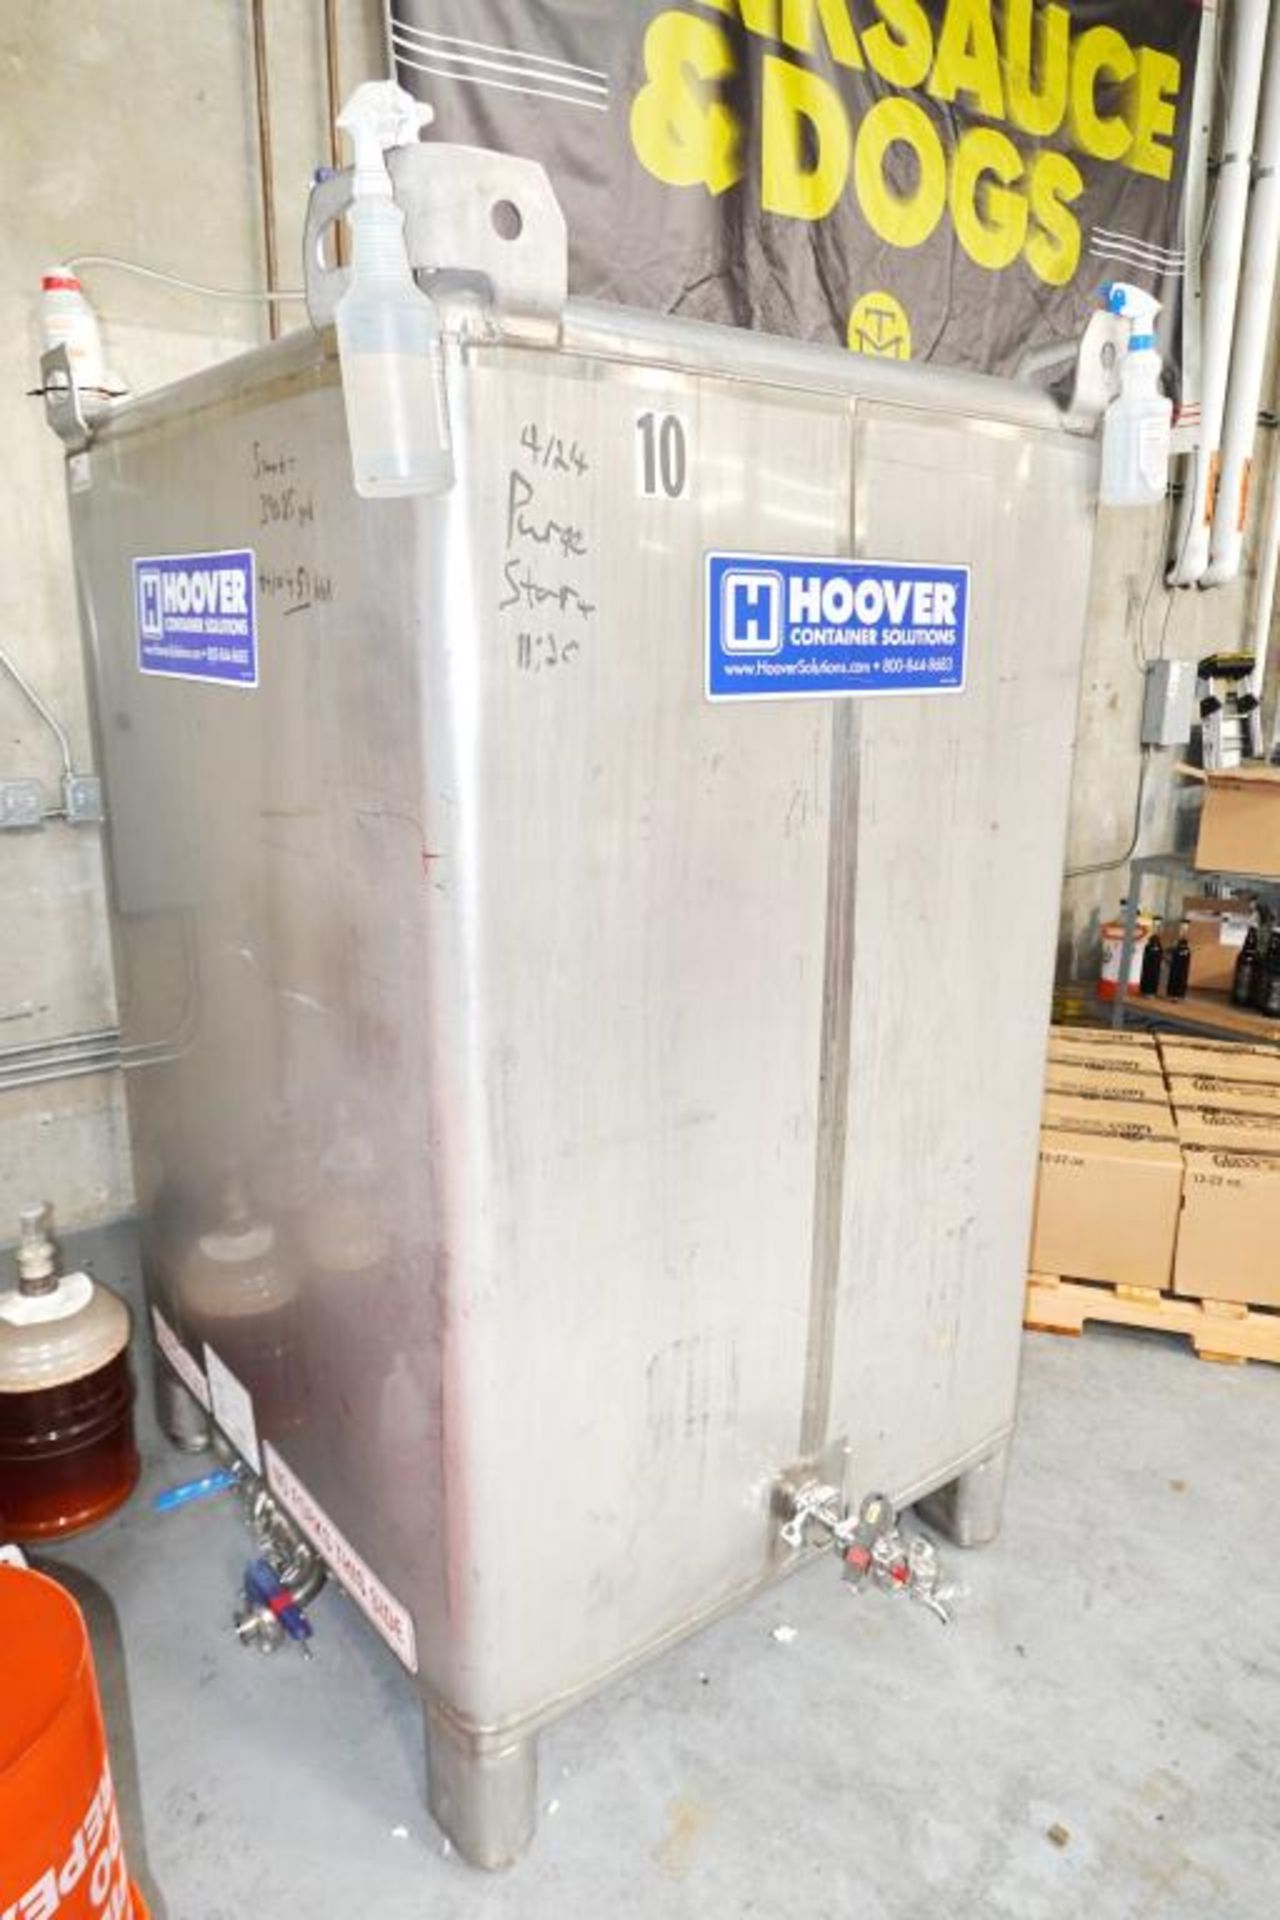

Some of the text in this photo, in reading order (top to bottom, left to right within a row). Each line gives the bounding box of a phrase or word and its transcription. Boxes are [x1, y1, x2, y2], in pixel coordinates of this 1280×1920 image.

[630, 12, 1084, 286] & DOGS
[637, 412, 686, 498] 10
[162, 569, 248, 614] HOOVER
[788, 576, 960, 627] HOOVER
[790, 627, 956, 647] CONTAINER SOLUTIONS
